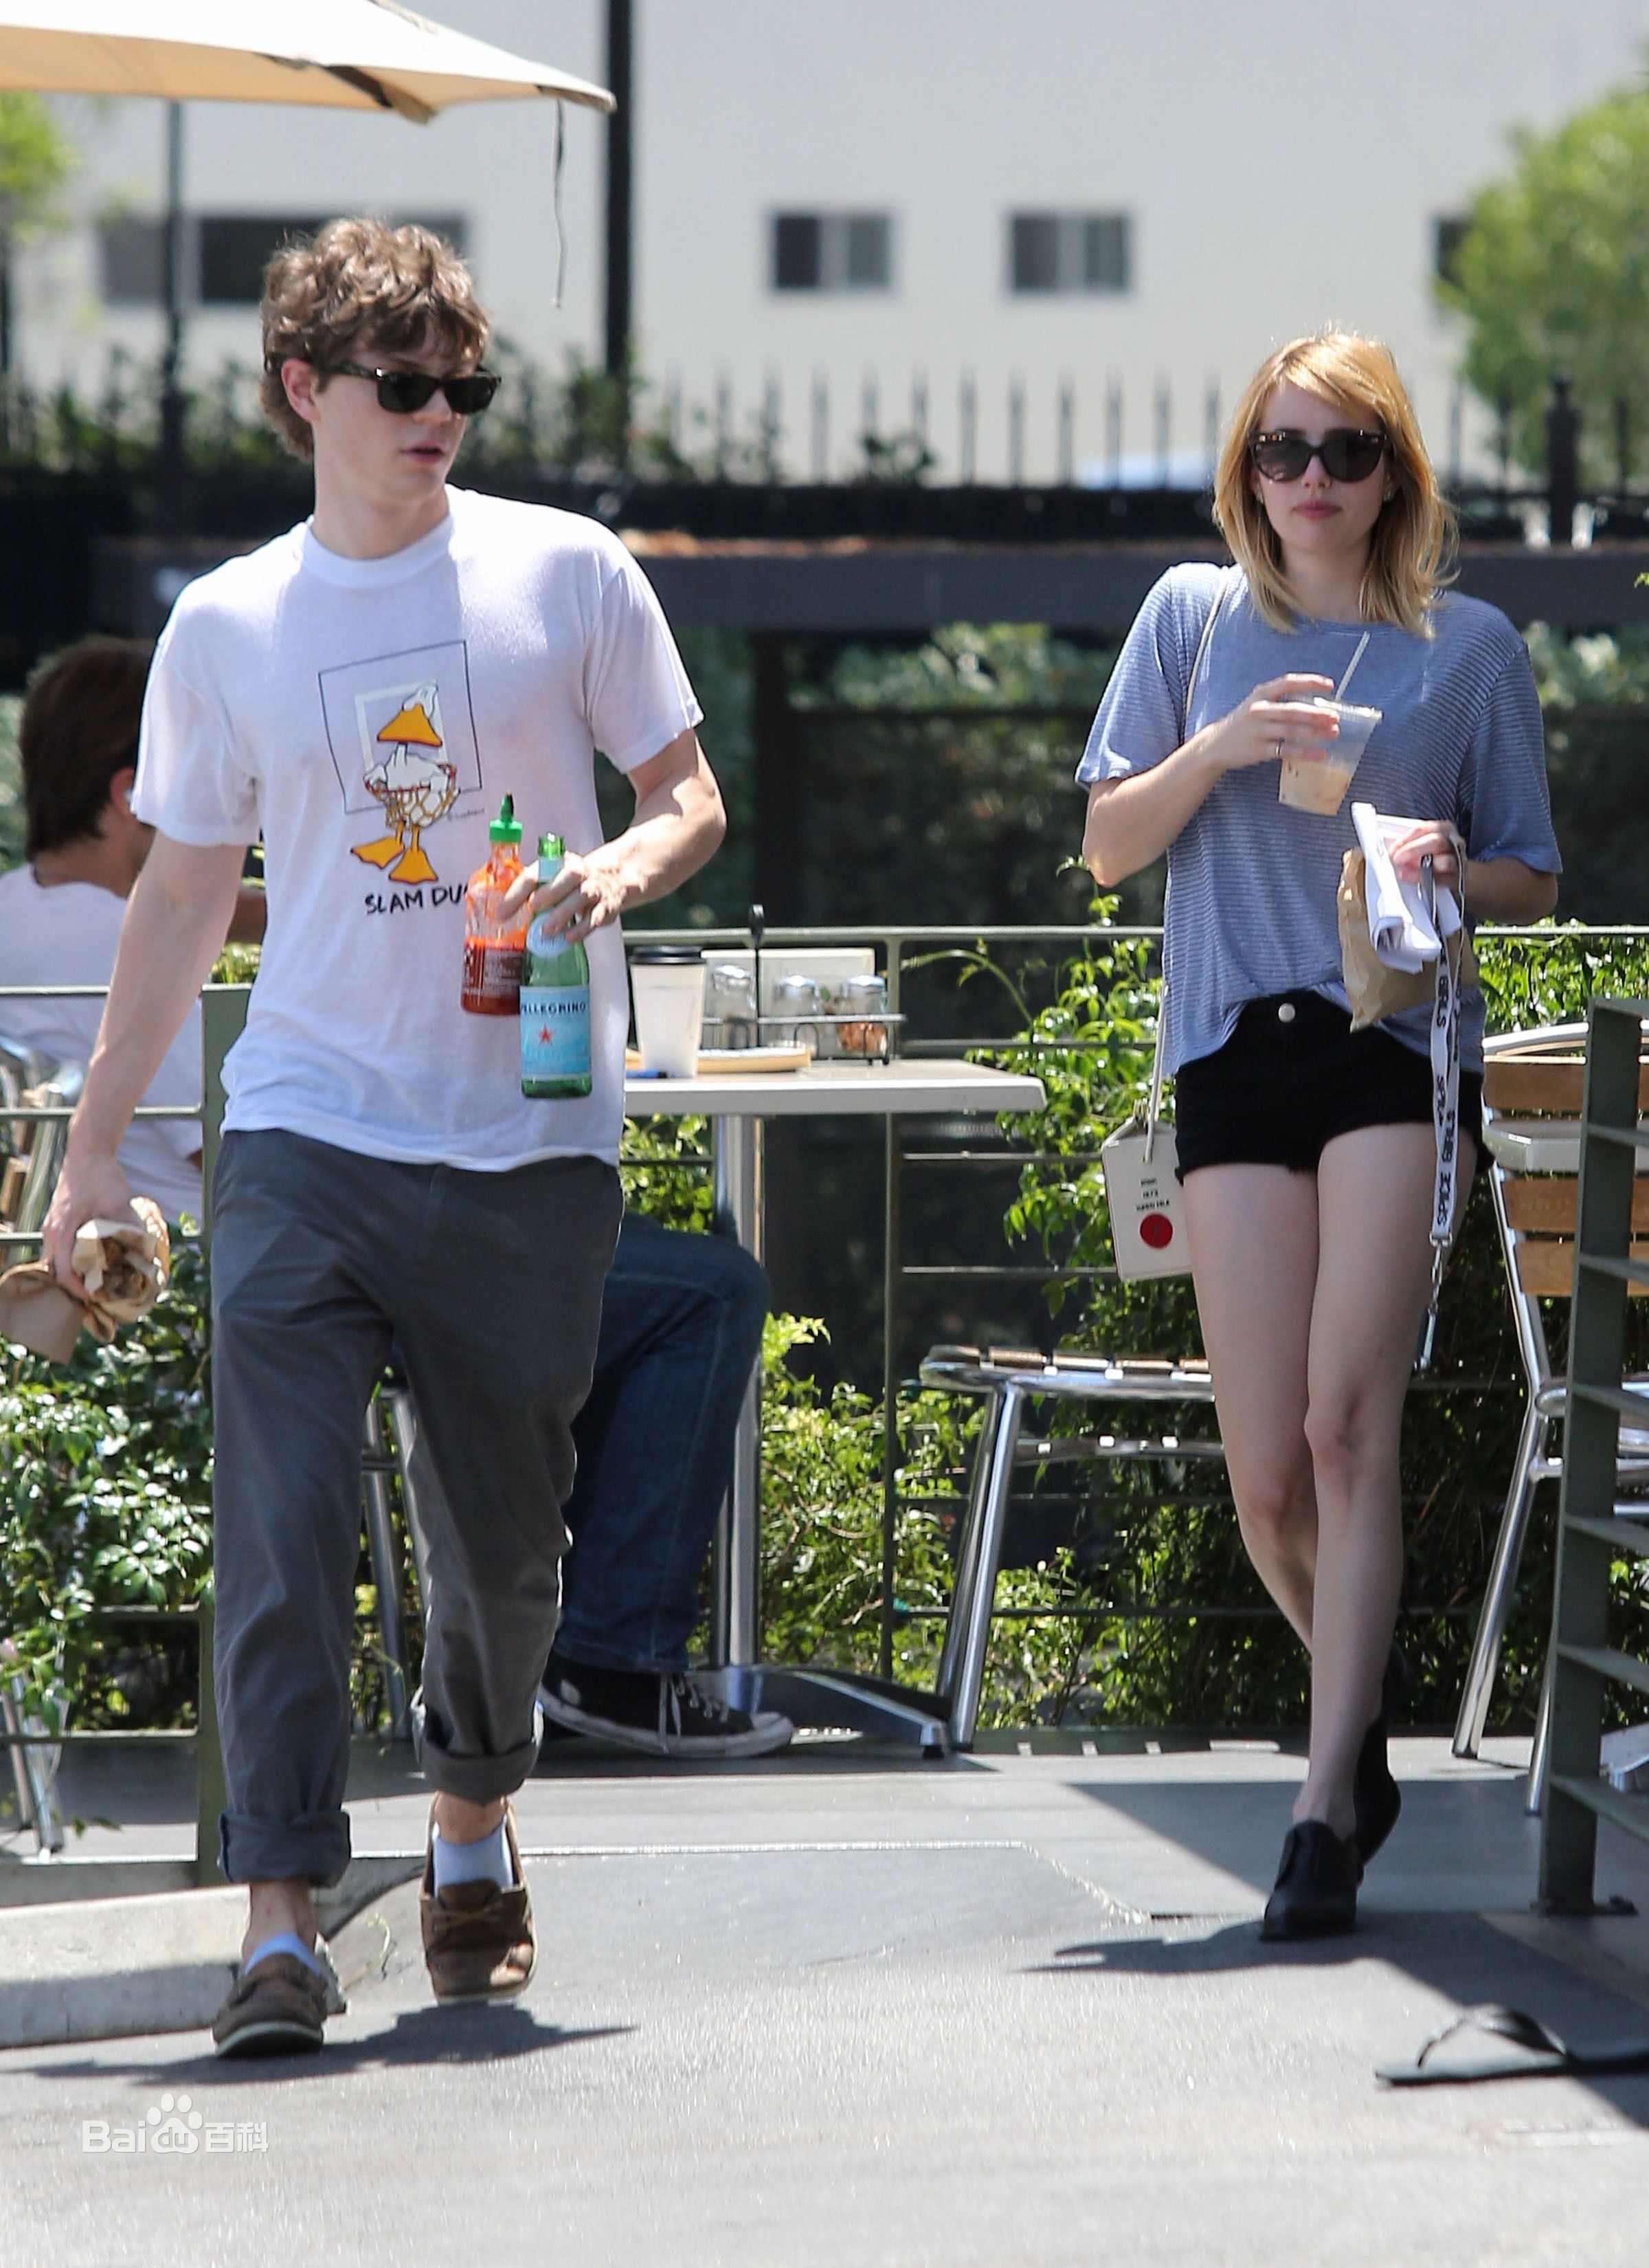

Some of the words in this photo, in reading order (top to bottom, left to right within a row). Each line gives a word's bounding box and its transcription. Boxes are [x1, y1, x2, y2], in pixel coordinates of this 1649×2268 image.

[365, 889, 423, 915] SLAM
[1442, 1109, 1456, 1162] GIRLS
[1437, 1172, 1451, 1225] SPICE
